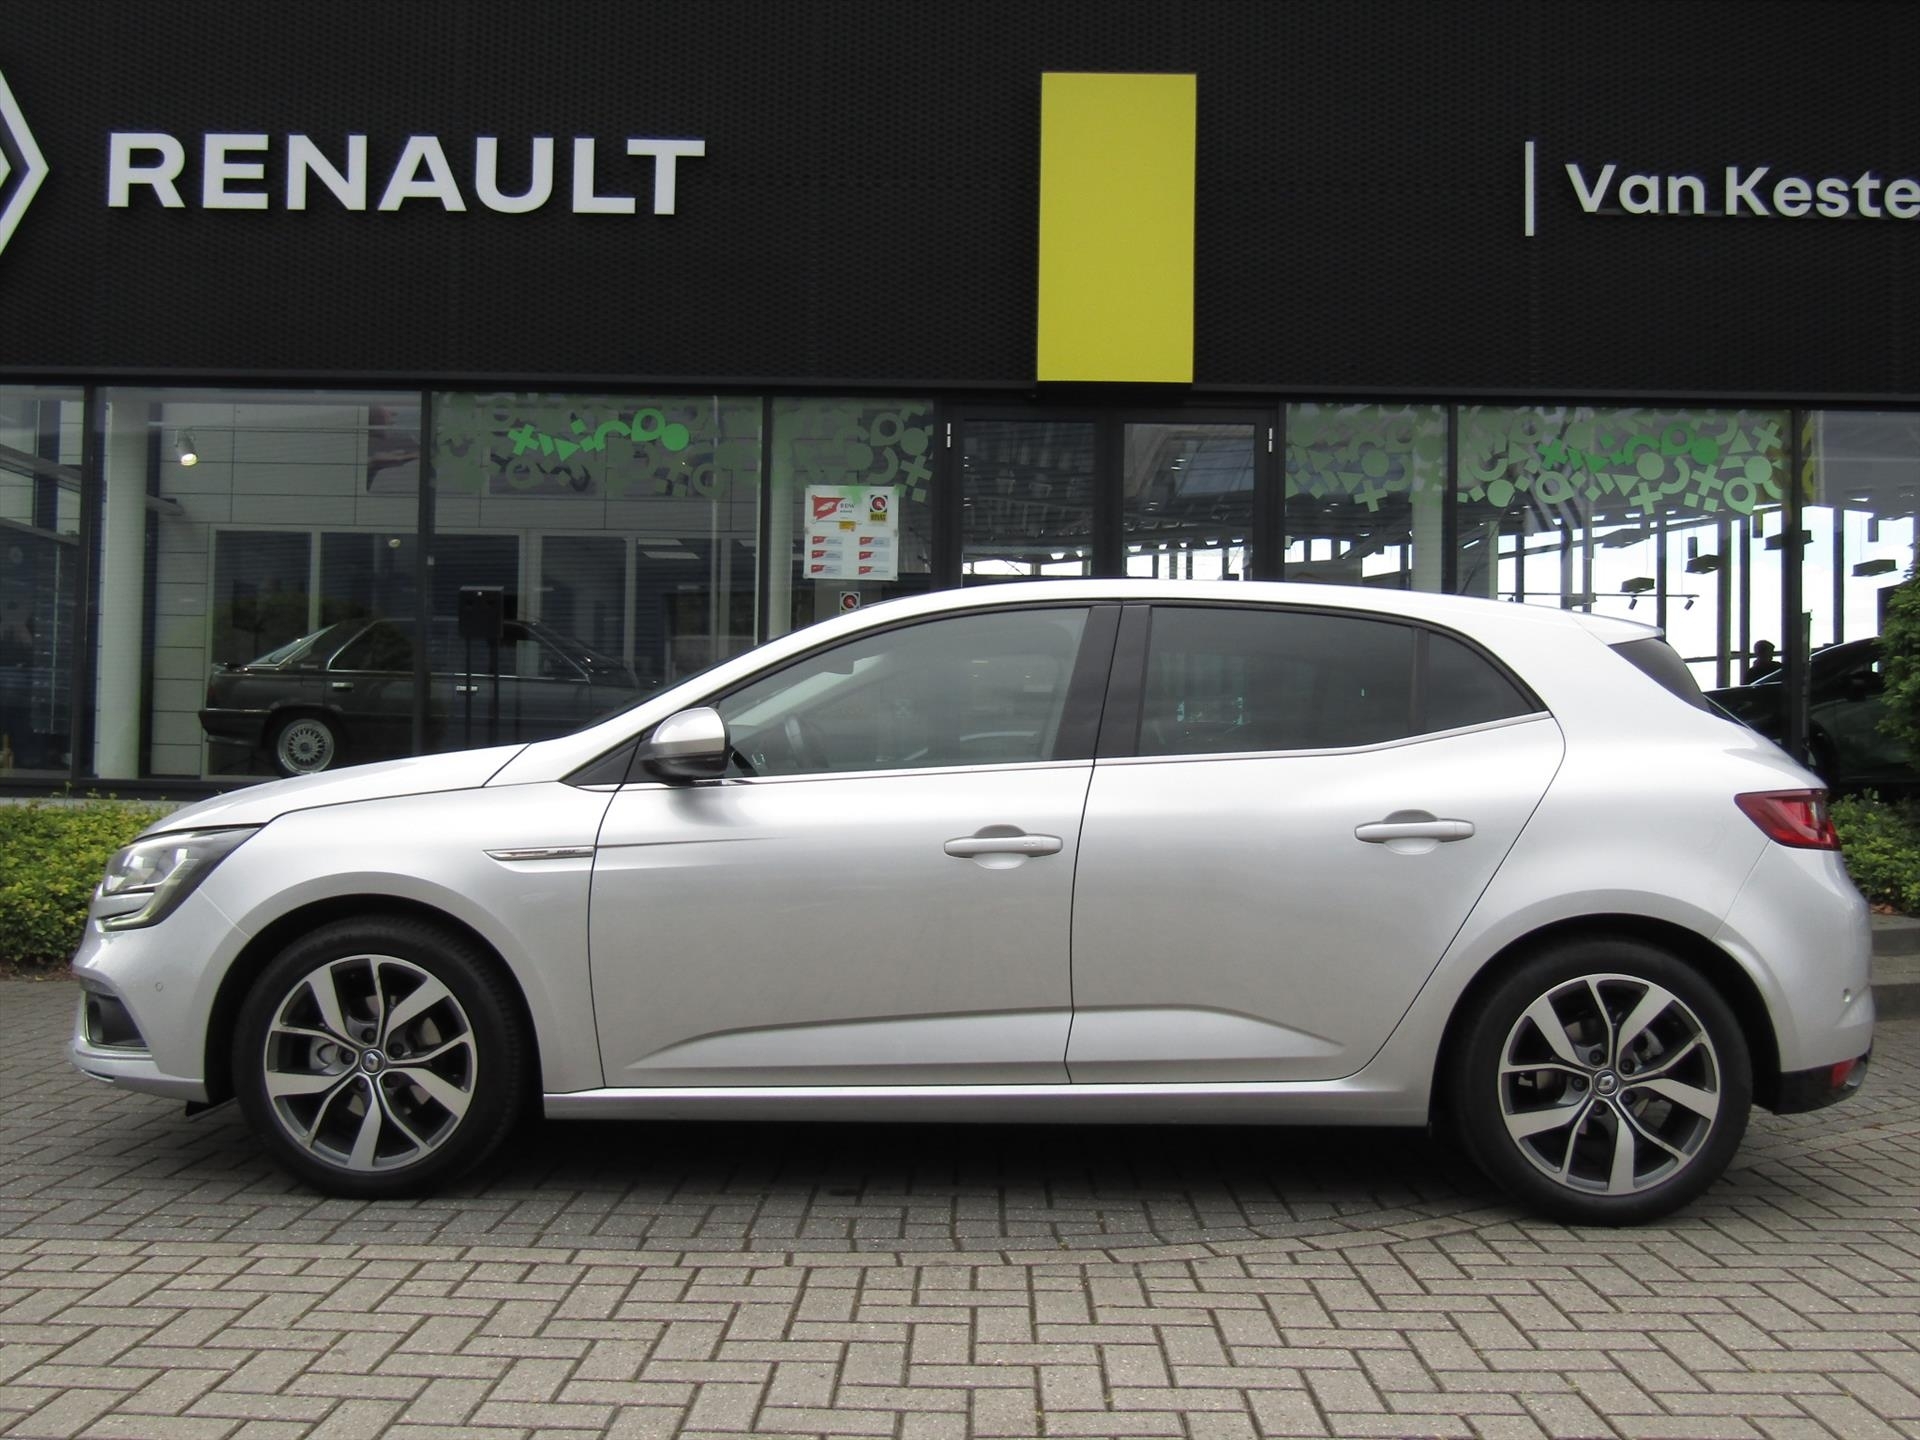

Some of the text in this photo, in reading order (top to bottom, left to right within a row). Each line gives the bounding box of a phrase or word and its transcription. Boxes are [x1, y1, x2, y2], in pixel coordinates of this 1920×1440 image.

[107, 132, 706, 215] RENAULT
[1565, 163, 1920, 219] Van Keste
